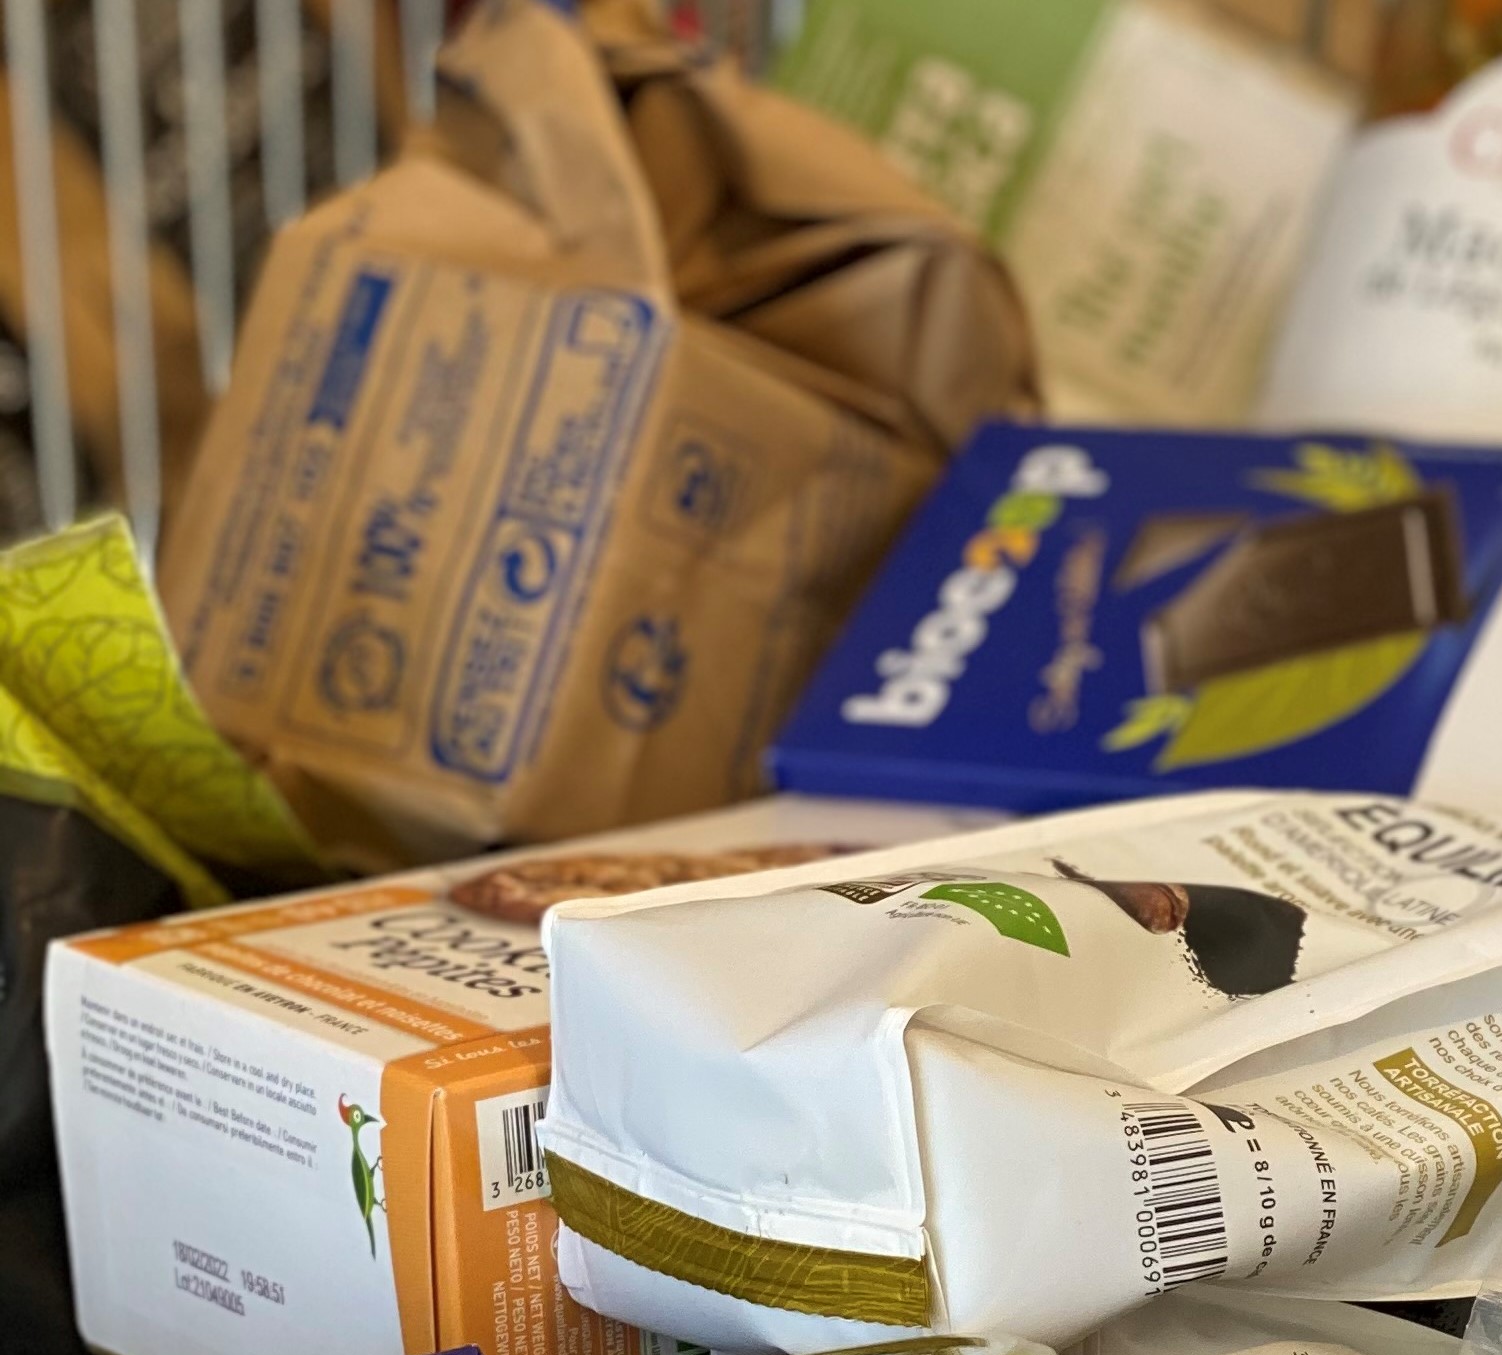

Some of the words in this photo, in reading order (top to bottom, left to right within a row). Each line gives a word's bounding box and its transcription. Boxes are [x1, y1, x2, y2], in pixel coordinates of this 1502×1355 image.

[841, 444, 1110, 728] biocoop
[1383, 889, 1460, 927] LATINE
[253, 987, 310, 1014] AVEYRON
[313, 1013, 369, 1036] FRANCE
[376, 999, 463, 1040] noisettes
[424, 1058, 453, 1069] Si
[456, 1046, 504, 1060] tous
[507, 1037, 541, 1048] les
[1383, 1068, 1486, 1137] ARTISANALE
[514, 1172, 545, 1193] 268
[1321, 1179, 1336, 1202] EN
[1121, 1112, 1149, 1198] 483981
[1136, 1210, 1162, 1297] 000691
[525, 1212, 538, 1253] POIDS
[1302, 1208, 1336, 1266] FRANCE
